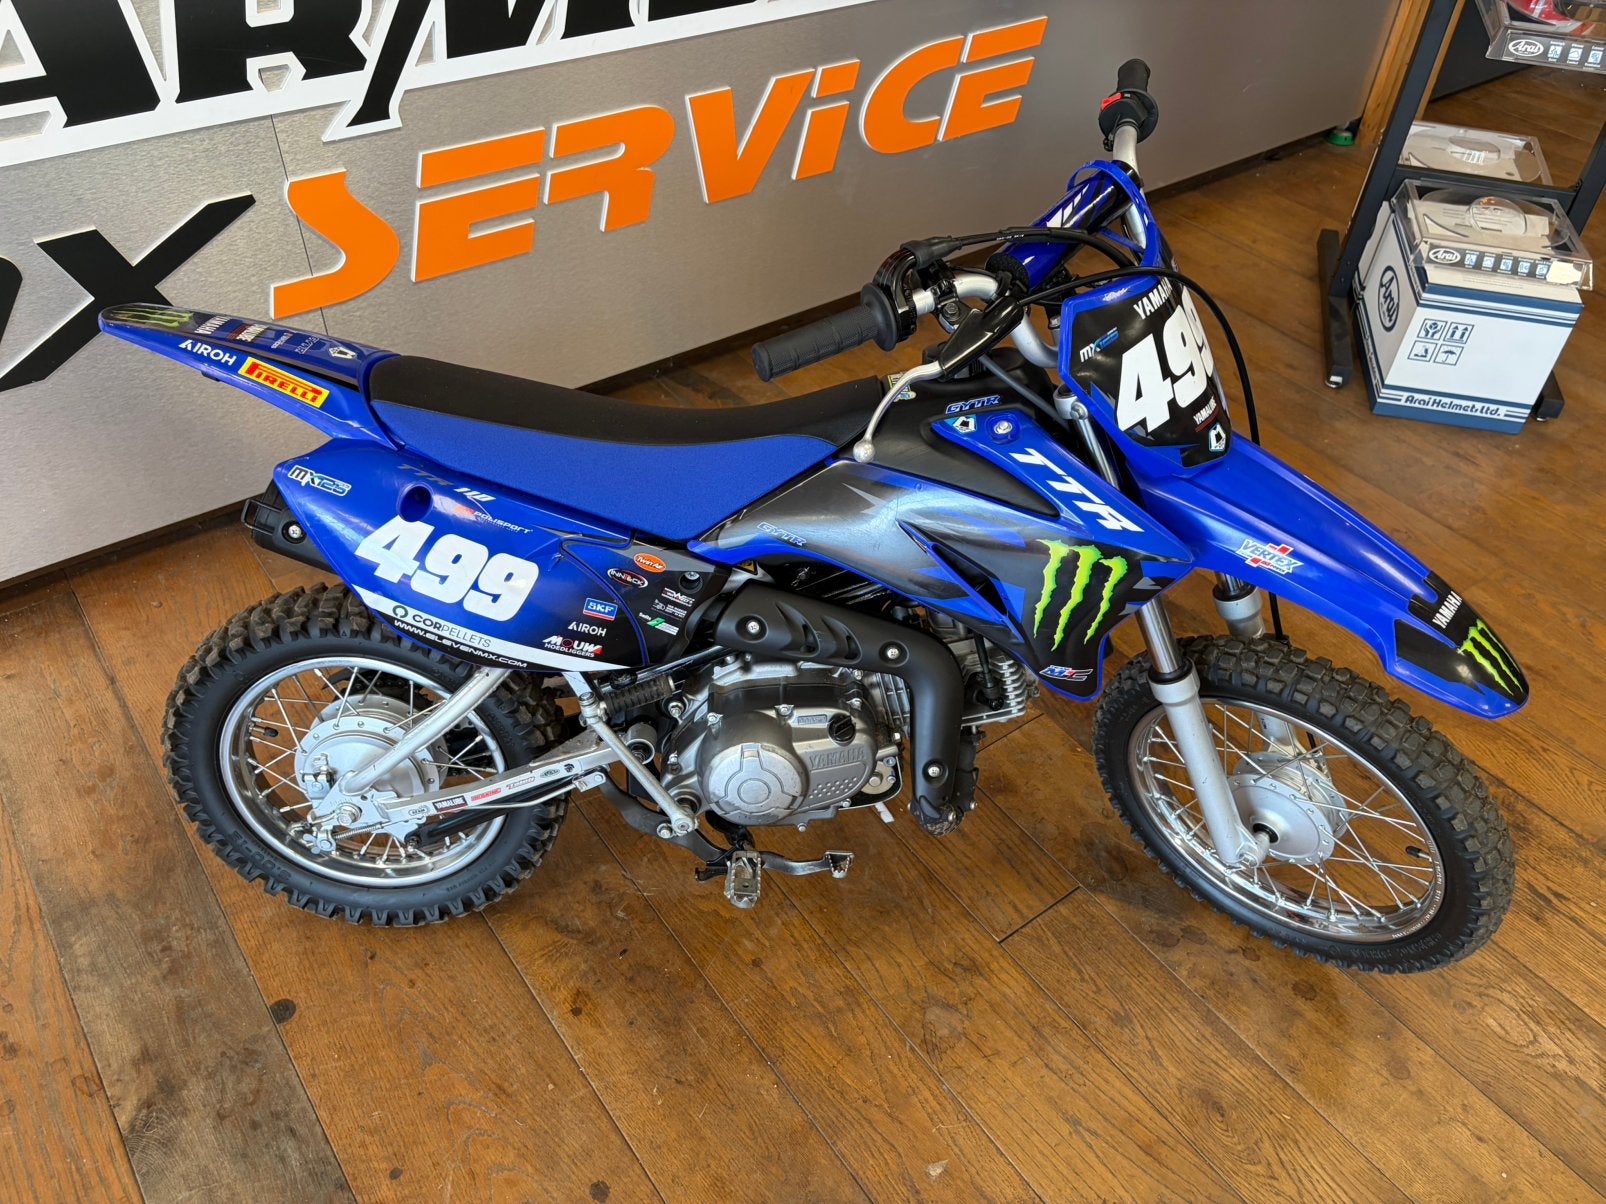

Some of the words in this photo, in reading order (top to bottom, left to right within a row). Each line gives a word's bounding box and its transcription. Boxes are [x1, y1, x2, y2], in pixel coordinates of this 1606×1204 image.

[178, 339, 236, 366] AIROH
[1117, 285, 1214, 432] 499
[245, 361, 323, 403] PIRELLI
[353, 514, 540, 622] 499
[1240, 540, 1300, 570] VERTEX
[587, 601, 614, 613] SKF
[1431, 590, 1463, 629] YAMAHA
[412, 614, 493, 649] CORPELLETS
[567, 621, 607, 637] AIROH
[544, 643, 595, 658] HOEDLIGGERS
[809, 747, 866, 770] YAMAHA
